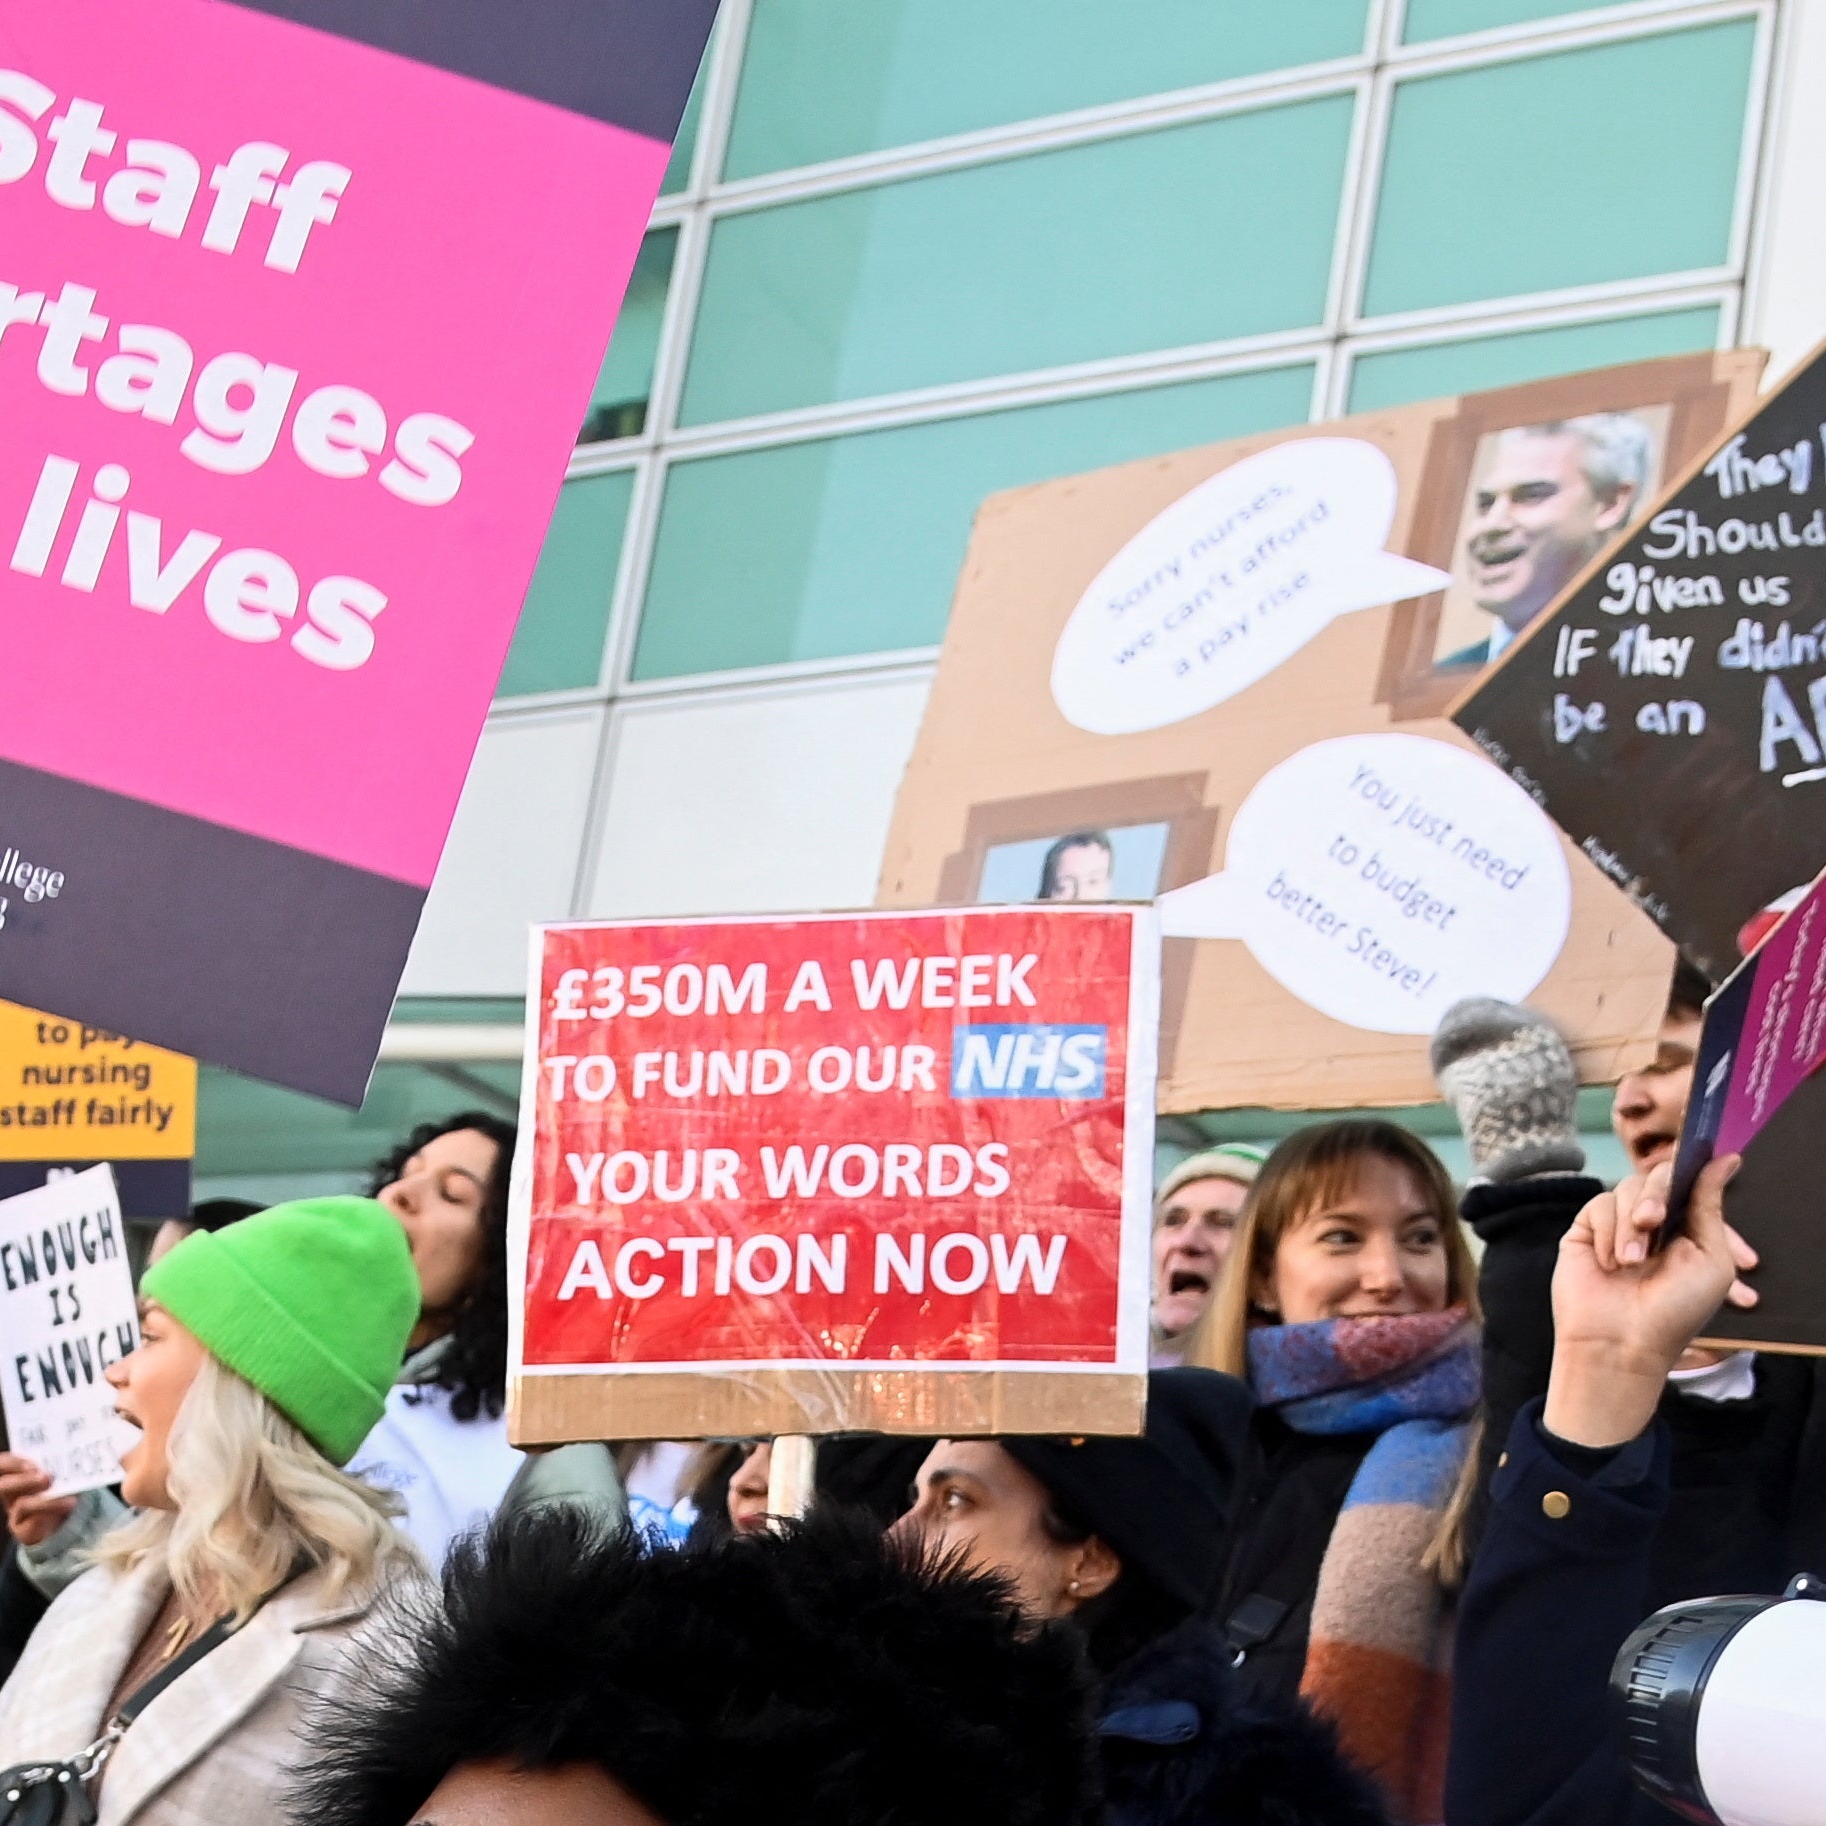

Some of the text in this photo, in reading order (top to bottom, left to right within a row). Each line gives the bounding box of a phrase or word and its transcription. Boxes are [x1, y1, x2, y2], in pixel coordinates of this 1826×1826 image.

[1704, 431, 1812, 499] They
[10, 453, 389, 670] lives
[1598, 559, 1725, 616] given
[1737, 572, 1792, 608] us
[1552, 691, 1607, 746] be
[1634, 698, 1709, 738] an
[1348, 760, 1399, 812] You
[1392, 794, 1457, 846] just
[1451, 835, 1530, 892] need
[1327, 832, 1458, 931] to budget
[1265, 867, 1438, 999] better Steve!
[551, 952, 1040, 1022] £350M A WEEK
[36, 1021, 69, 1044] to
[22, 1055, 151, 1092] nursing
[545, 1033, 1103, 1104] TO FUND OUR NHS
[86, 1096, 174, 1132] fairly
[565, 1142, 1011, 1207] YOUR WORDS
[0, 1207, 118, 1291] ENOUGH
[556, 1233, 1069, 1301] ACTION NOW
[49, 1283, 81, 1326] IS
